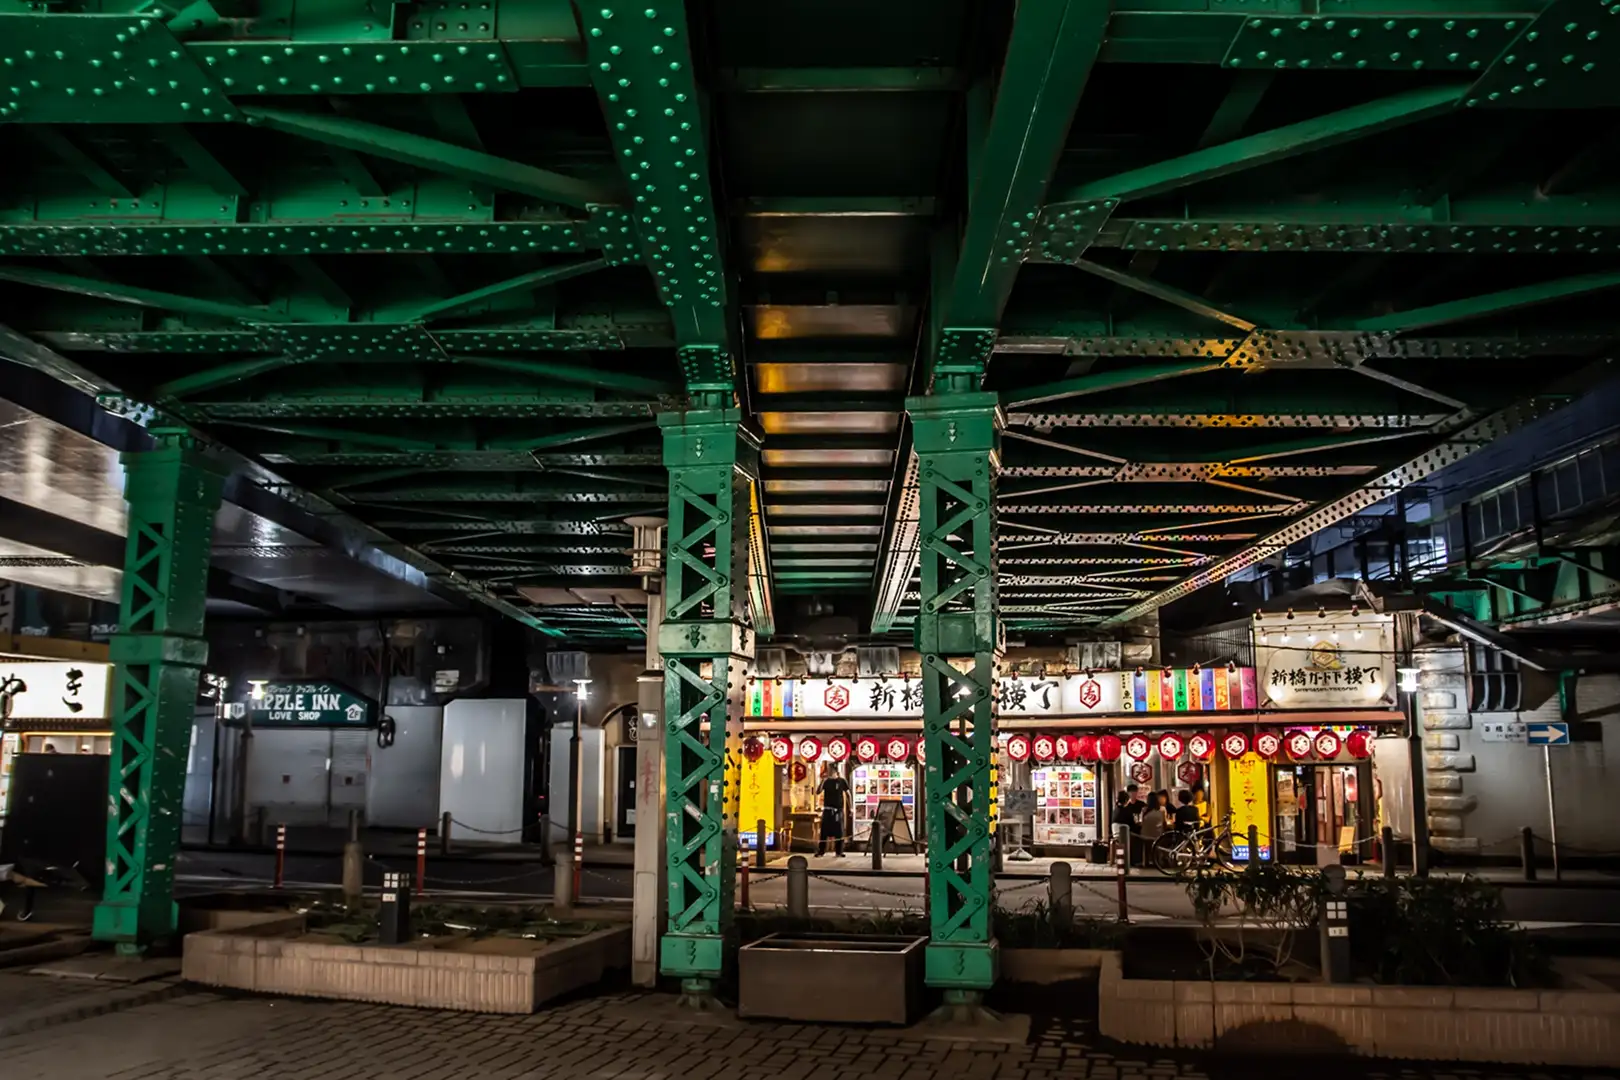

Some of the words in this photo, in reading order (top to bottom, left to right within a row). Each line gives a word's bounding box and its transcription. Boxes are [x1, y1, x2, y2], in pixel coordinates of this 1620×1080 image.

[312, 694, 341, 711] INN
[269, 711, 292, 720] LOVE
[298, 711, 321, 720] SHOP
[349, 707, 359, 719] 2F
